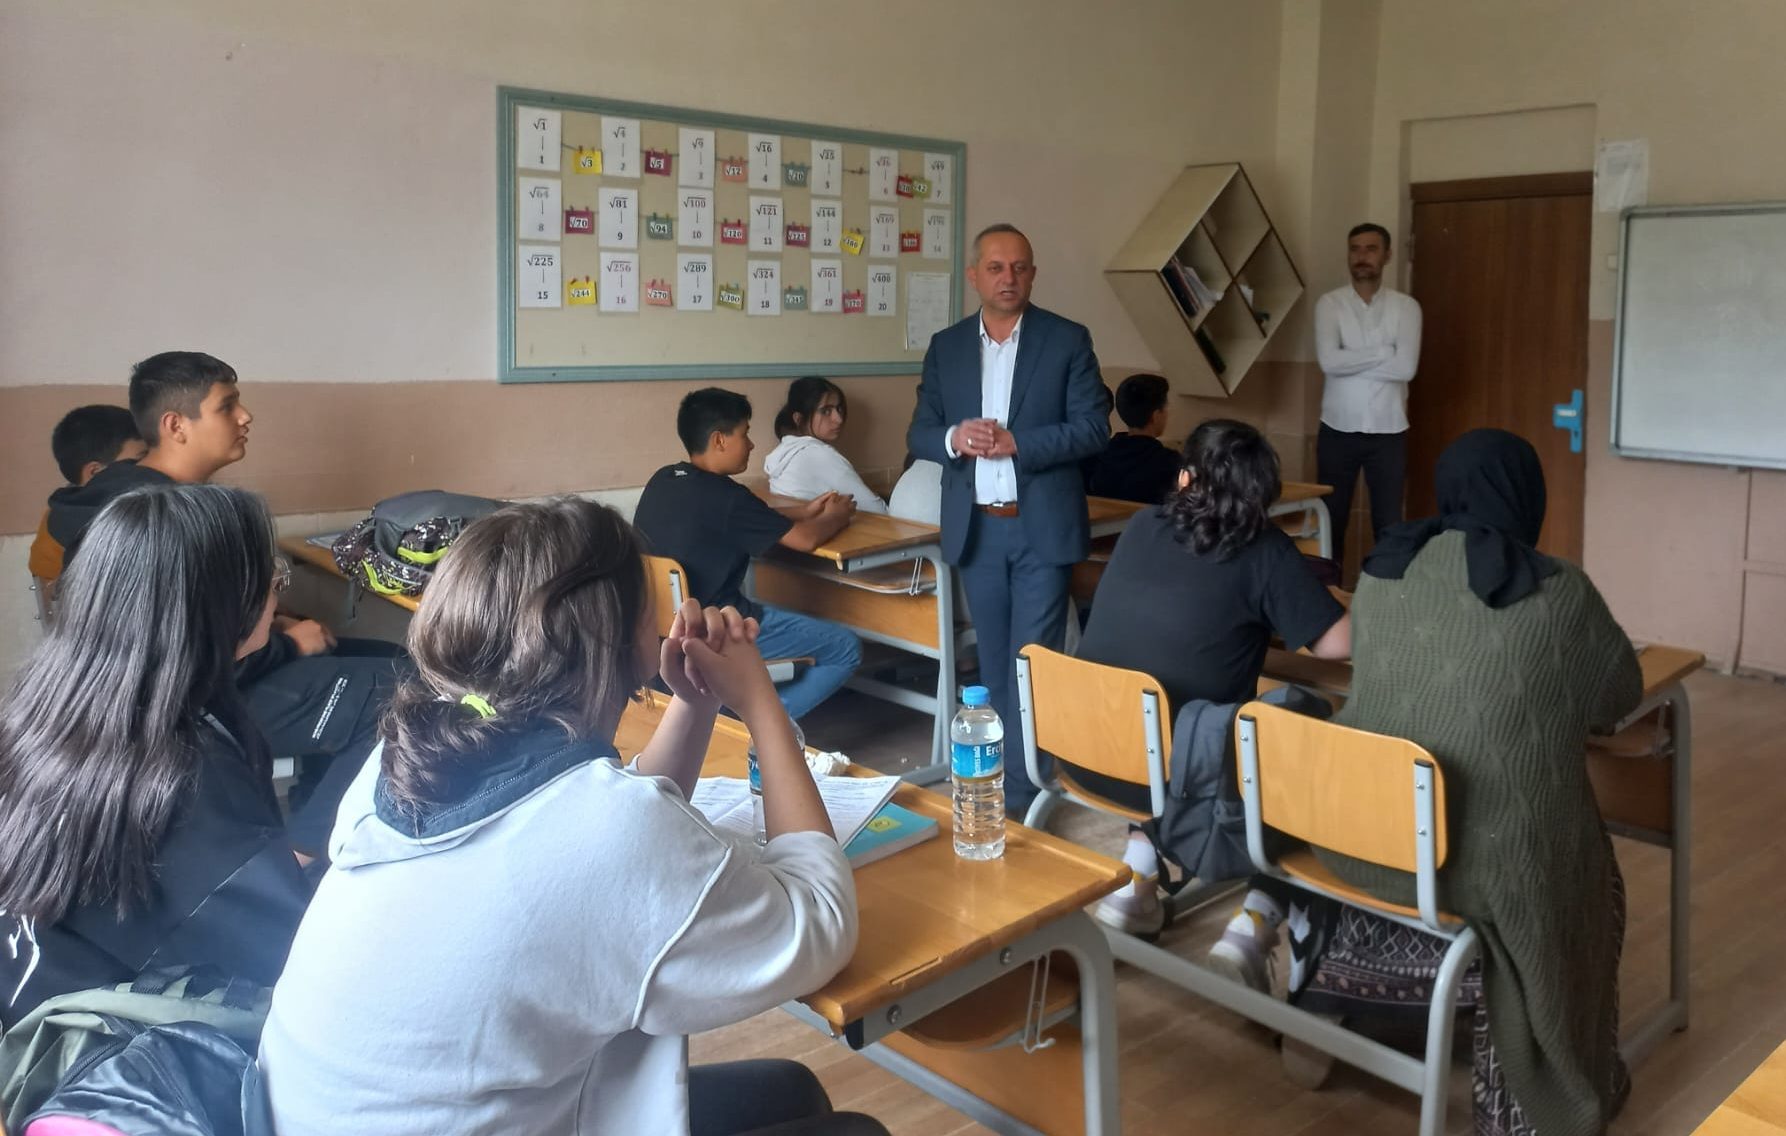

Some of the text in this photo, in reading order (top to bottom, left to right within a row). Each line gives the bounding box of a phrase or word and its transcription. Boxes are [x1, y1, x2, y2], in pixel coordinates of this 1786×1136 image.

[581, 156, 593, 168] √3
[609, 196, 628, 209] √81
[617, 232, 624, 241] 9
[692, 230, 702, 239] 10
[763, 236, 773, 245] 11
[823, 239, 832, 247] 12
[527, 254, 554, 267] √225
[607, 260, 632, 273] √256
[684, 261, 707, 273] √289
[537, 290, 549, 300] 15
[693, 294, 702, 303] 17
[616, 296, 627, 304] 16
[761, 300, 770, 309] 18
[878, 303, 887, 311] 20
